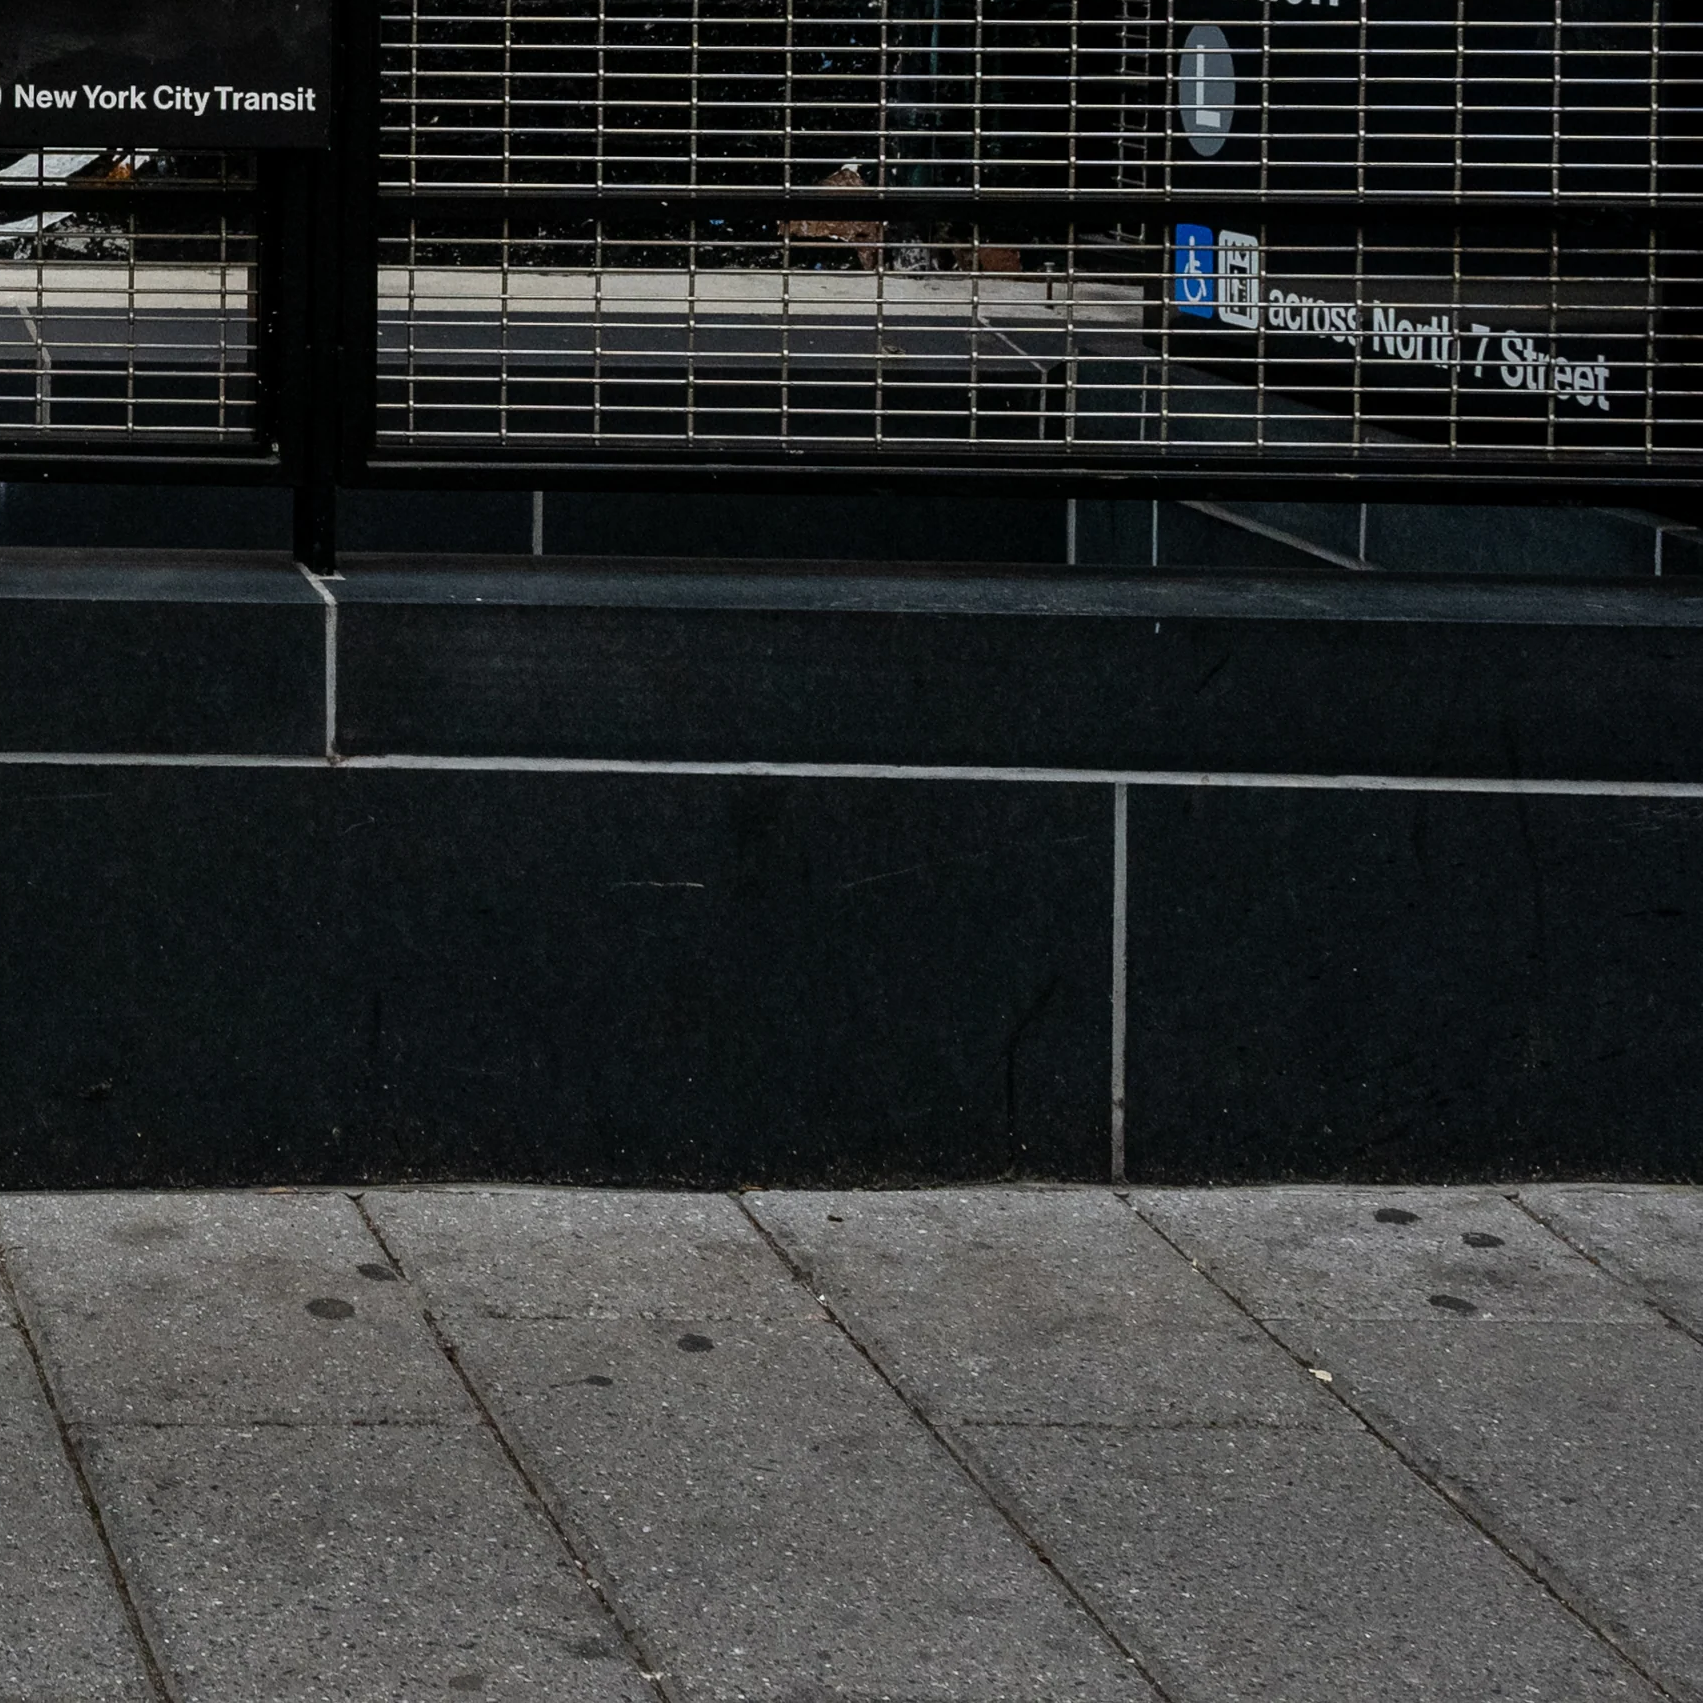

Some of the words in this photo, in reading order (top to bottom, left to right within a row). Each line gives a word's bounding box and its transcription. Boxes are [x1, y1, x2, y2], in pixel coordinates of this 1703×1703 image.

[15, 84, 77, 109] New
[83, 84, 147, 110] York
[153, 85, 210, 116] City
[214, 86, 316, 111] Transit
[1268, 287, 1363, 347] across
[1373, 299, 1460, 373] North
[1470, 323, 1490, 378] 7
[1501, 330, 1610, 411] Street
